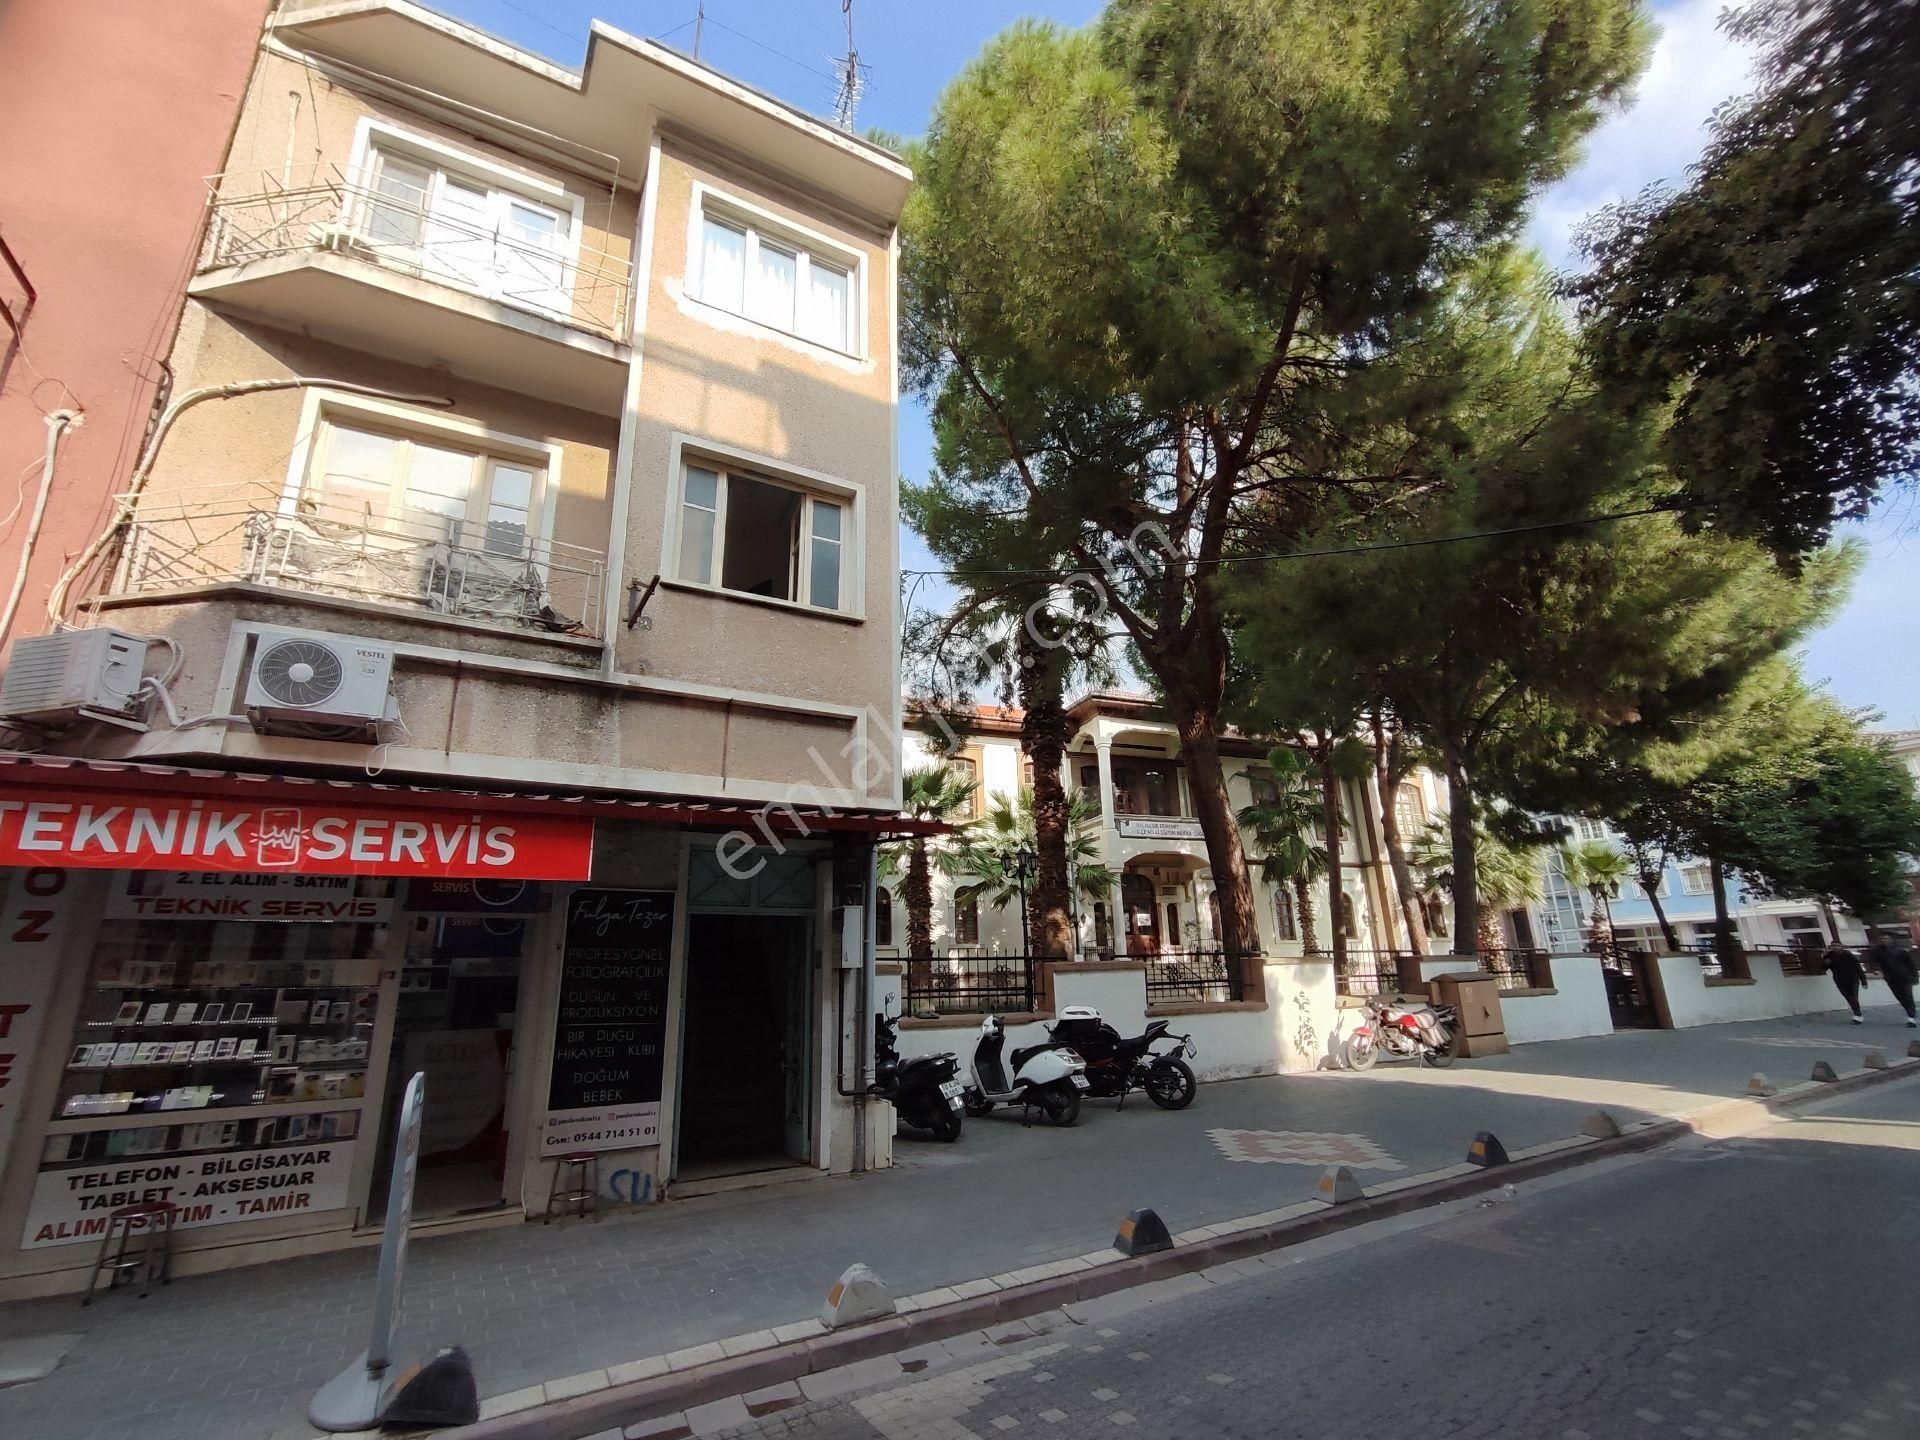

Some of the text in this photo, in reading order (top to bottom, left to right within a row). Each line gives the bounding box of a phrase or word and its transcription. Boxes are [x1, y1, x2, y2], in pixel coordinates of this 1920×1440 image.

[357, 650, 386, 660] VESTEL
[306, 815, 516, 866] SERVİS
[177, 872, 194, 885] 2.
[201, 873, 225, 885] EL
[231, 874, 277, 886] ALIM
[293, 876, 348, 889] SATIM
[432, 880, 470, 893] SERVİS
[128, 896, 377, 917] TEKNİK SERVİS
[568, 947, 664, 960] PROFESYONEL
[634, 990, 651, 1001] VE
[583, 1089, 623, 1103] BEBEK
[574, 1132, 601, 1143] 0544
[606, 1129, 625, 1139] 714
[629, 1127, 640, 1137] 51
[644, 1126, 656, 1135] 01
[67, 1165, 180, 1191] TELEFON
[201, 1150, 331, 1177] BİLGİSAYAR
[78, 1186, 174, 1211] TABLET
[193, 1171, 315, 1197] AKSESUAR
[34, 1217, 105, 1242] ALIM
[237, 1191, 311, 1216] TAMİR
